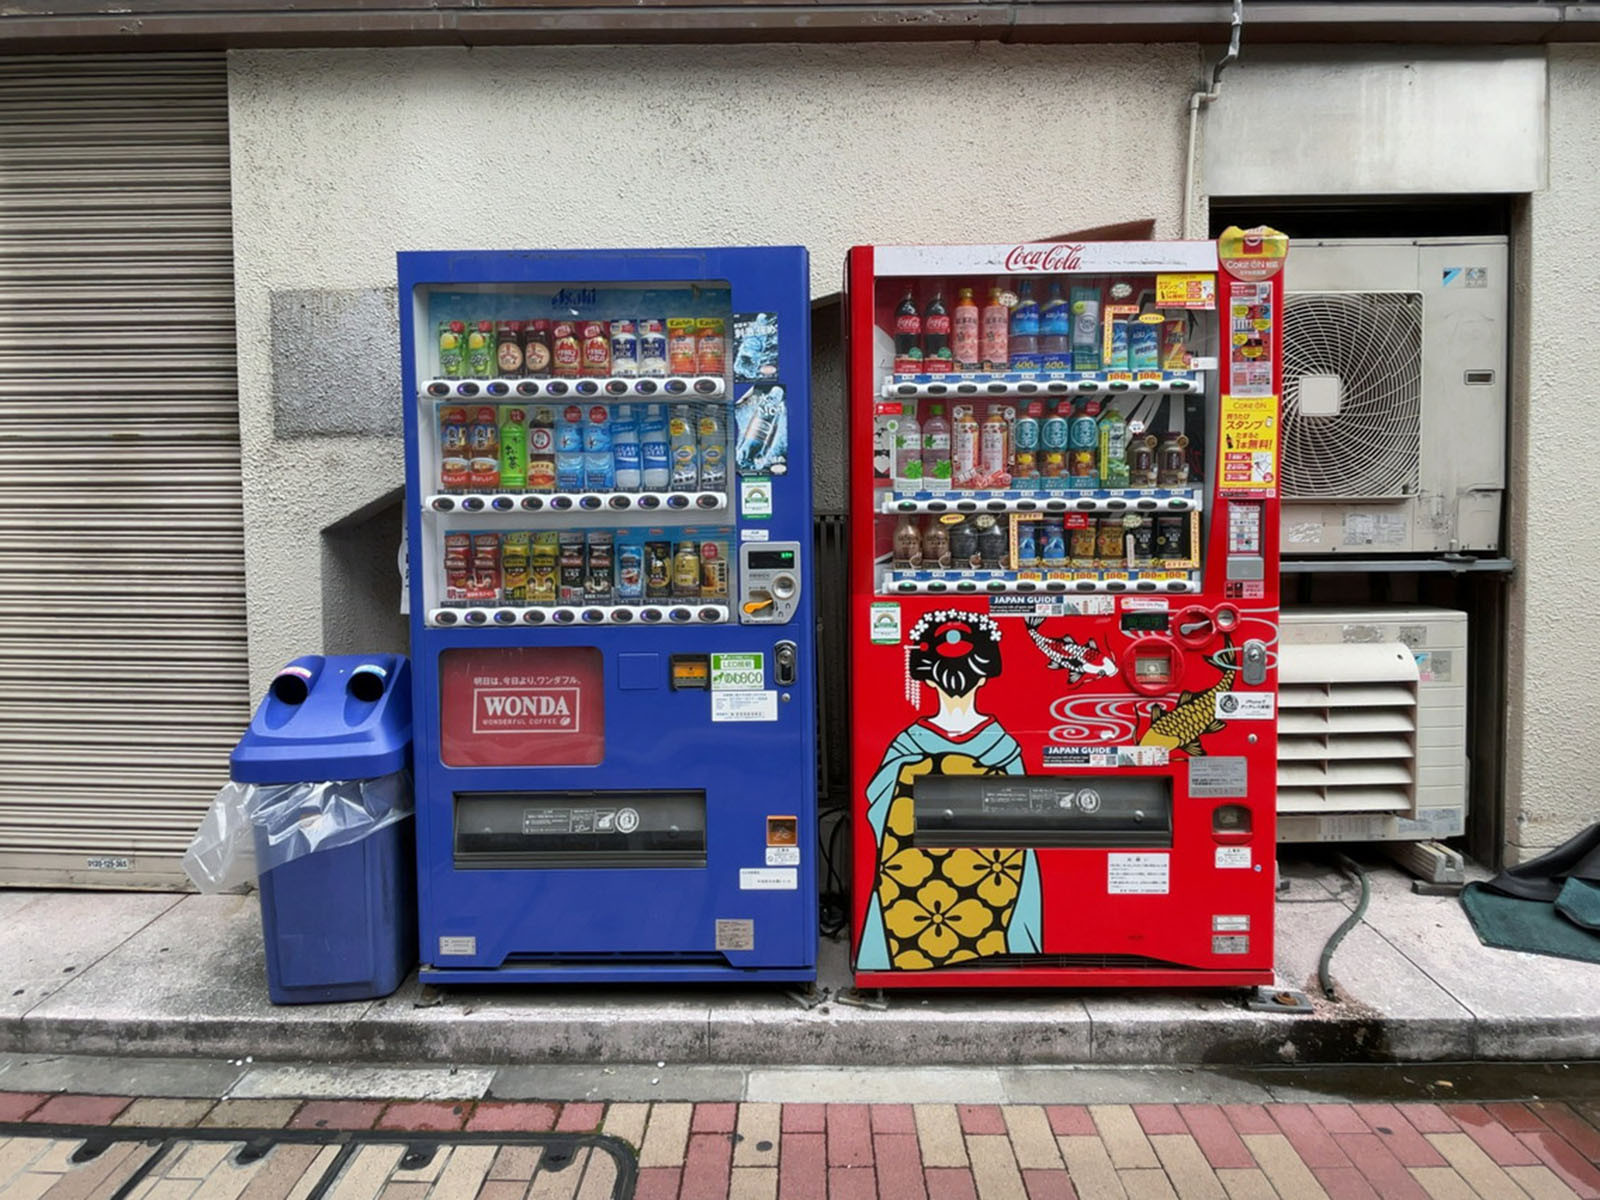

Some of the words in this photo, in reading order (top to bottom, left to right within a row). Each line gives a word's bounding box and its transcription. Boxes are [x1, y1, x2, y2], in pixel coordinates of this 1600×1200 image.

[1005, 244, 1084, 272] Coca-Cola
[551, 288, 597, 306] Asahi
[484, 696, 570, 716] WONDA
[482, 718, 526, 726] WONDERFUL
